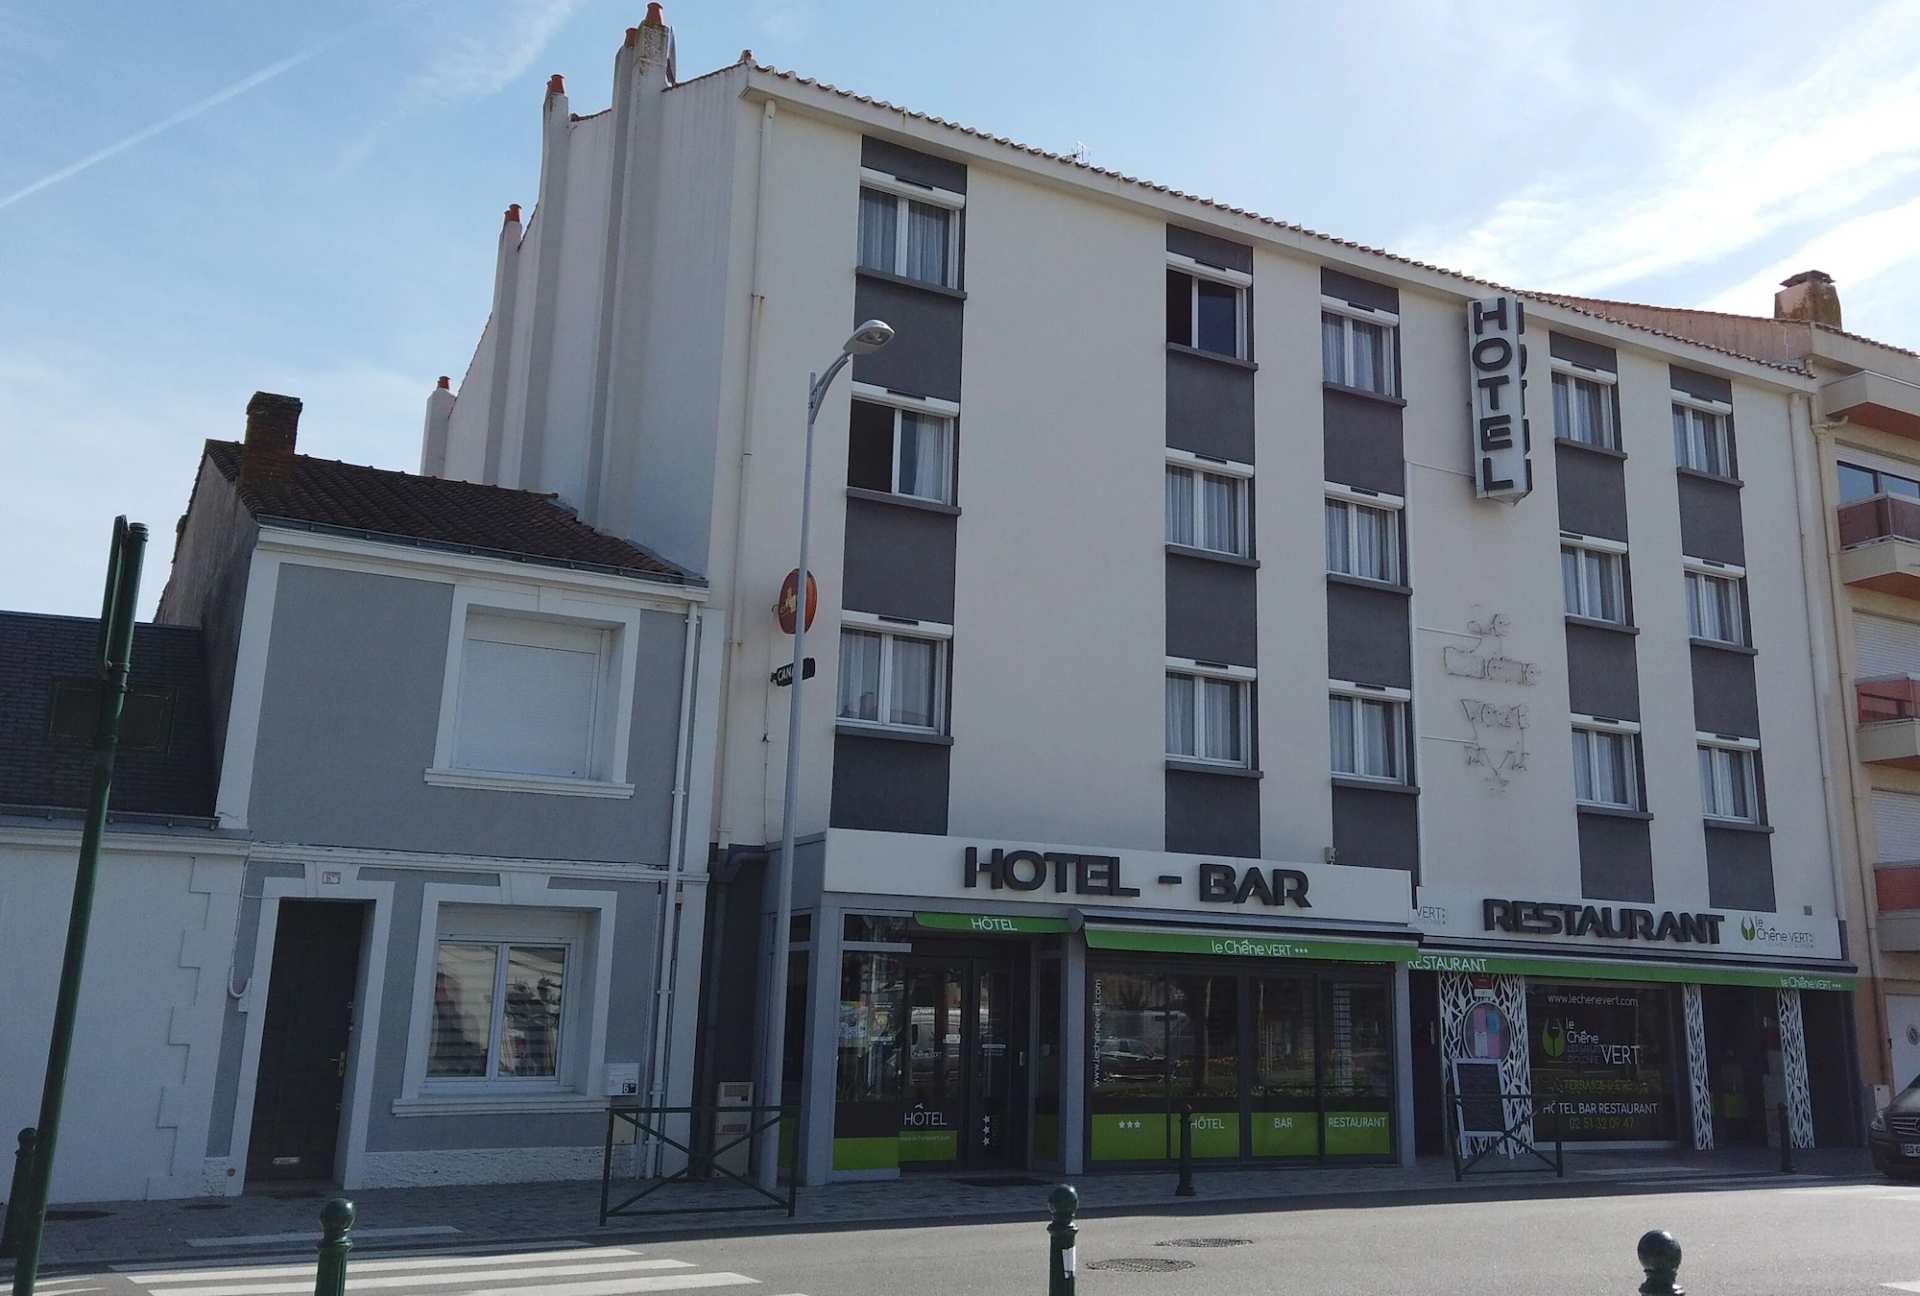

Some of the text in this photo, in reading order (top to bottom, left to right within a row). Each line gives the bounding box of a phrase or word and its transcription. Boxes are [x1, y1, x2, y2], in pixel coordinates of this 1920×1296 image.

[1472, 297, 1513, 490] HOTEL
[964, 846, 1139, 897] HOTEL
[1200, 863, 1312, 908] BAR
[970, 915, 1018, 931] HÔTEL
[1483, 898, 1724, 945] RESTAURANT
[1265, 943, 1292, 957] VERT
[1565, 1016, 1575, 1030] le
[1601, 1045, 1640, 1065] VERT
[1578, 1103, 1597, 1114] BAR
[1598, 1103, 1658, 1115] RESTAURANT
[1273, 1117, 1293, 1129] BAR
[1327, 1116, 1386, 1129] RESTAURANT
